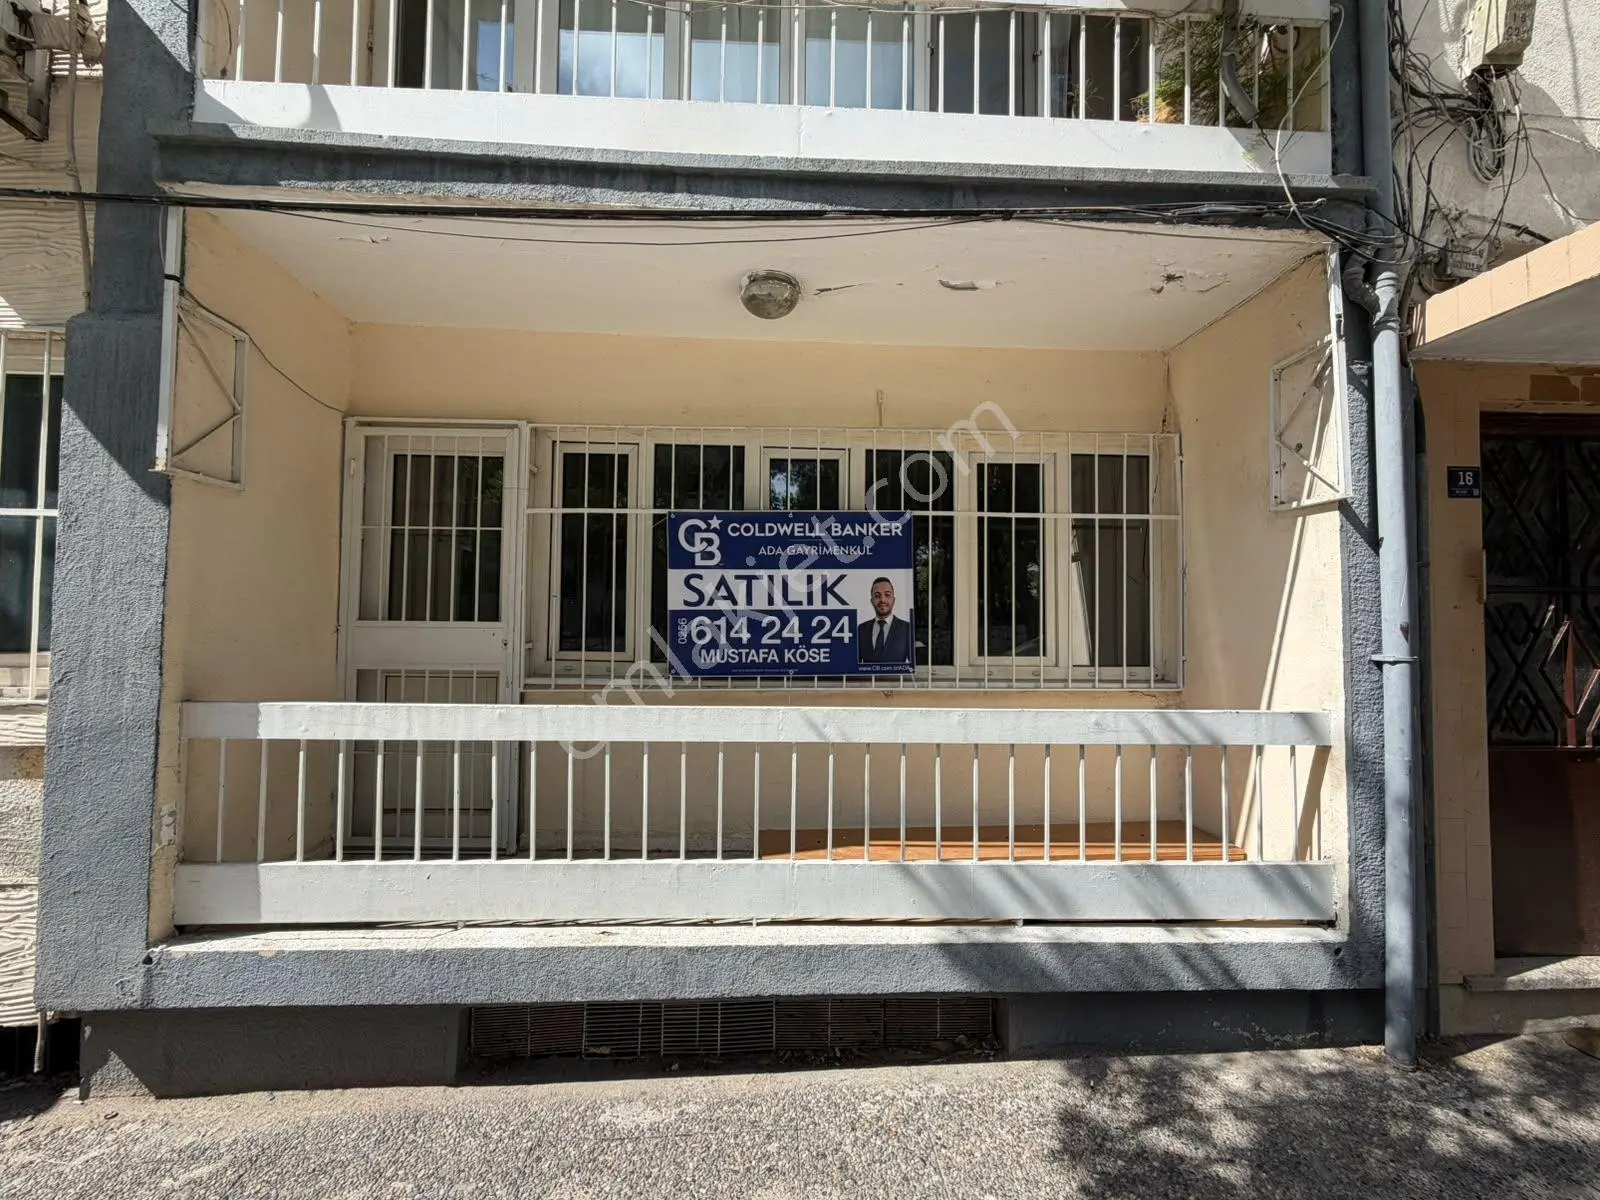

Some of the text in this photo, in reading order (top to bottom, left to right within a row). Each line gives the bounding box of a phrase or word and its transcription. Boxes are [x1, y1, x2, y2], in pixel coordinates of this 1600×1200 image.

[1458, 471, 1474, 486] 16
[727, 522, 903, 537] COLDWELL BANKER
[678, 518, 722, 566] CB
[758, 543, 873, 556] ADA GAYRİMENKUL
[683, 573, 850, 607] SATILIK
[677, 617, 688, 645] 0256
[690, 615, 853, 645] 614 24 24
[700, 645, 831, 663] MUSTAFA KÖSE
